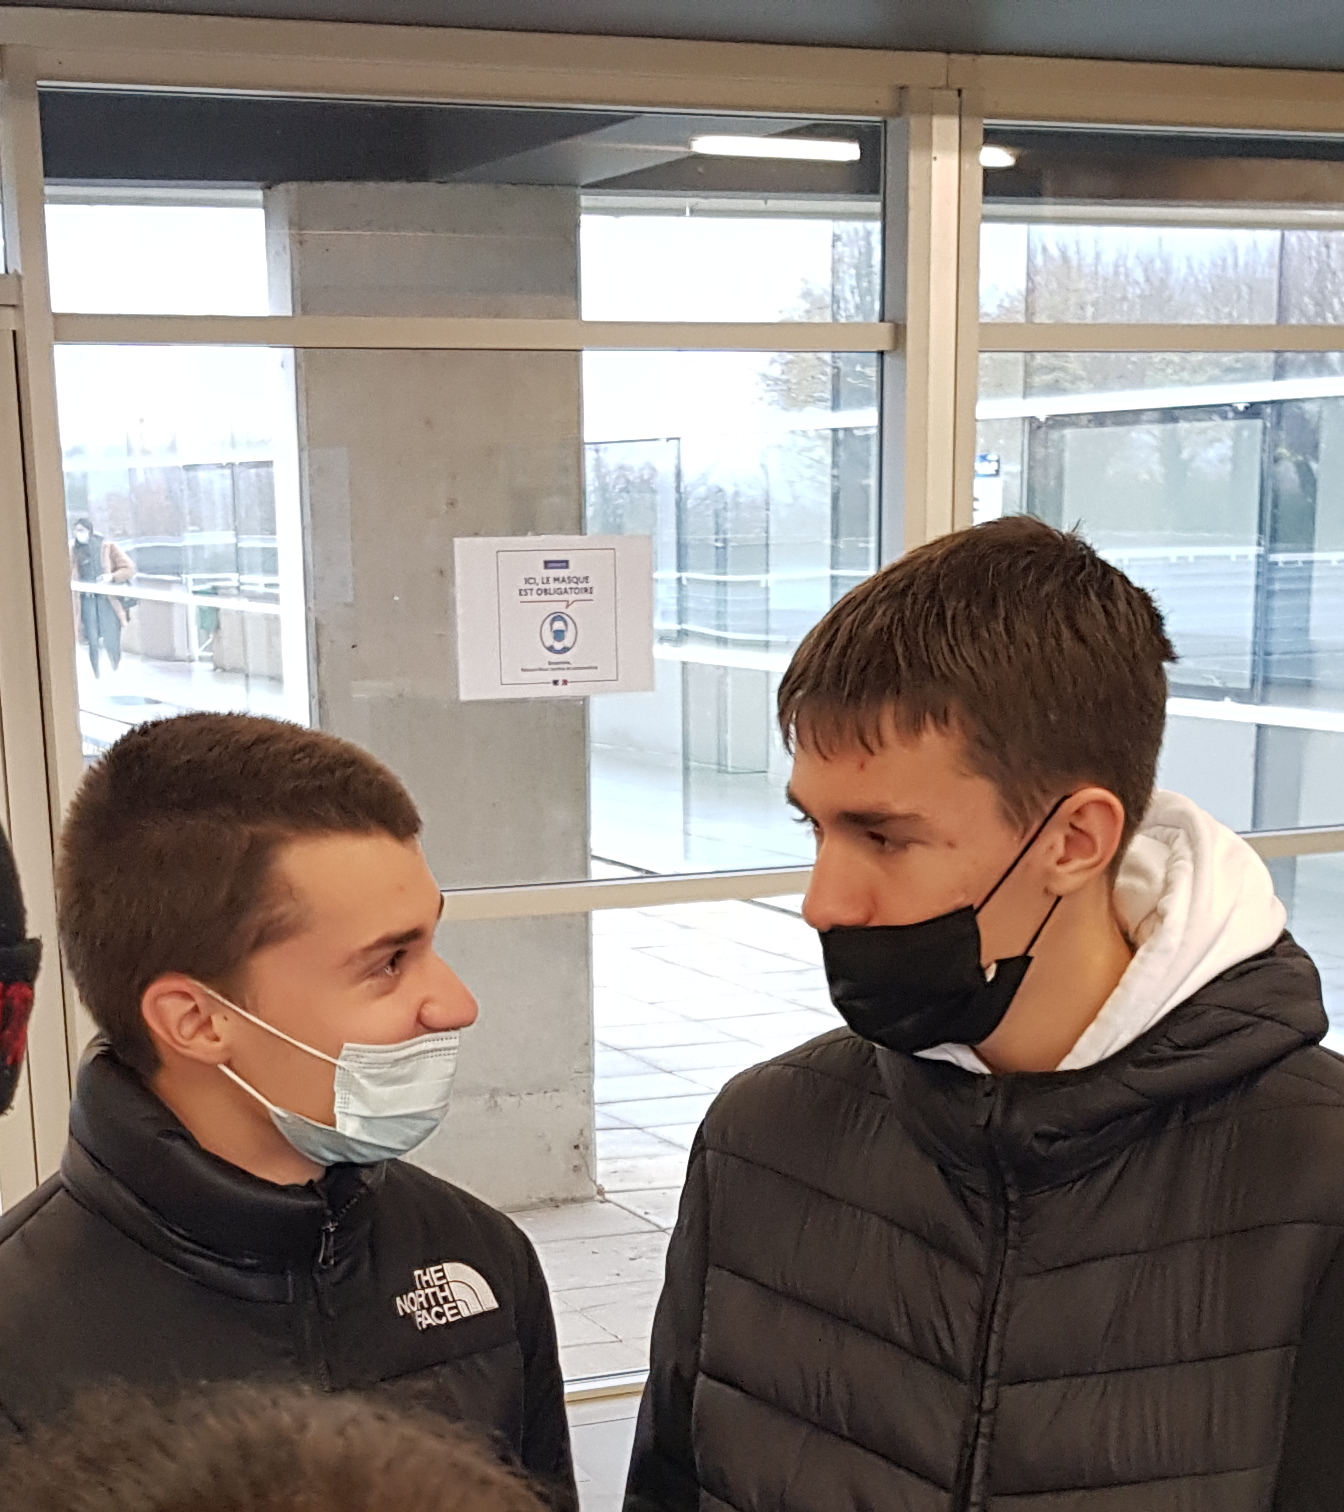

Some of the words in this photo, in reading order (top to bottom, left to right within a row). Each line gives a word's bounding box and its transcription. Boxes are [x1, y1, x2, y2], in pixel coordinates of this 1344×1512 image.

[518, 588, 534, 597] EST
[535, 586, 594, 597] OBLIGATOIRE
[541, 577, 550, 585] LE
[553, 576, 590, 586] MASQUE
[413, 1264, 447, 1290] THE
[395, 1284, 454, 1316] NORTH
[414, 1302, 462, 1331] FACE
